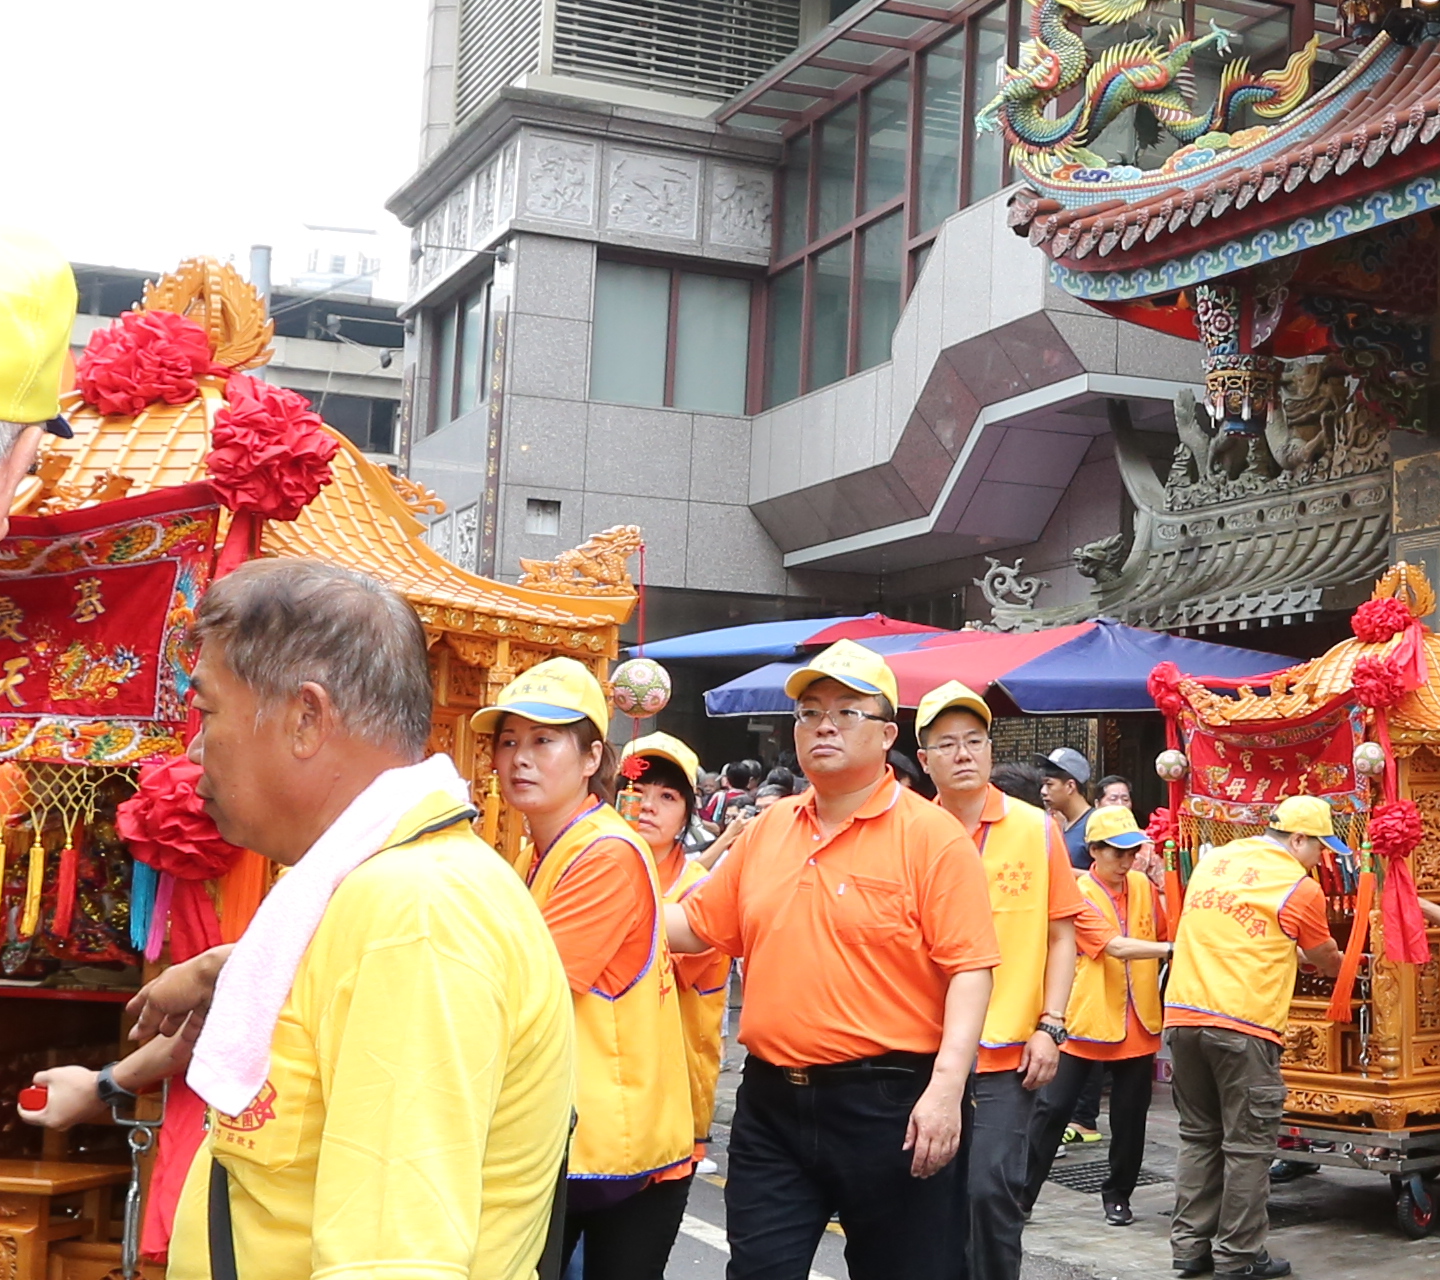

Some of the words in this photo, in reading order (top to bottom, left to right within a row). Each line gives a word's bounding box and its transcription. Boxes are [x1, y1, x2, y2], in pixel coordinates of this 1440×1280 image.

[1181, 887, 1268, 938] 安宮媽祖會
